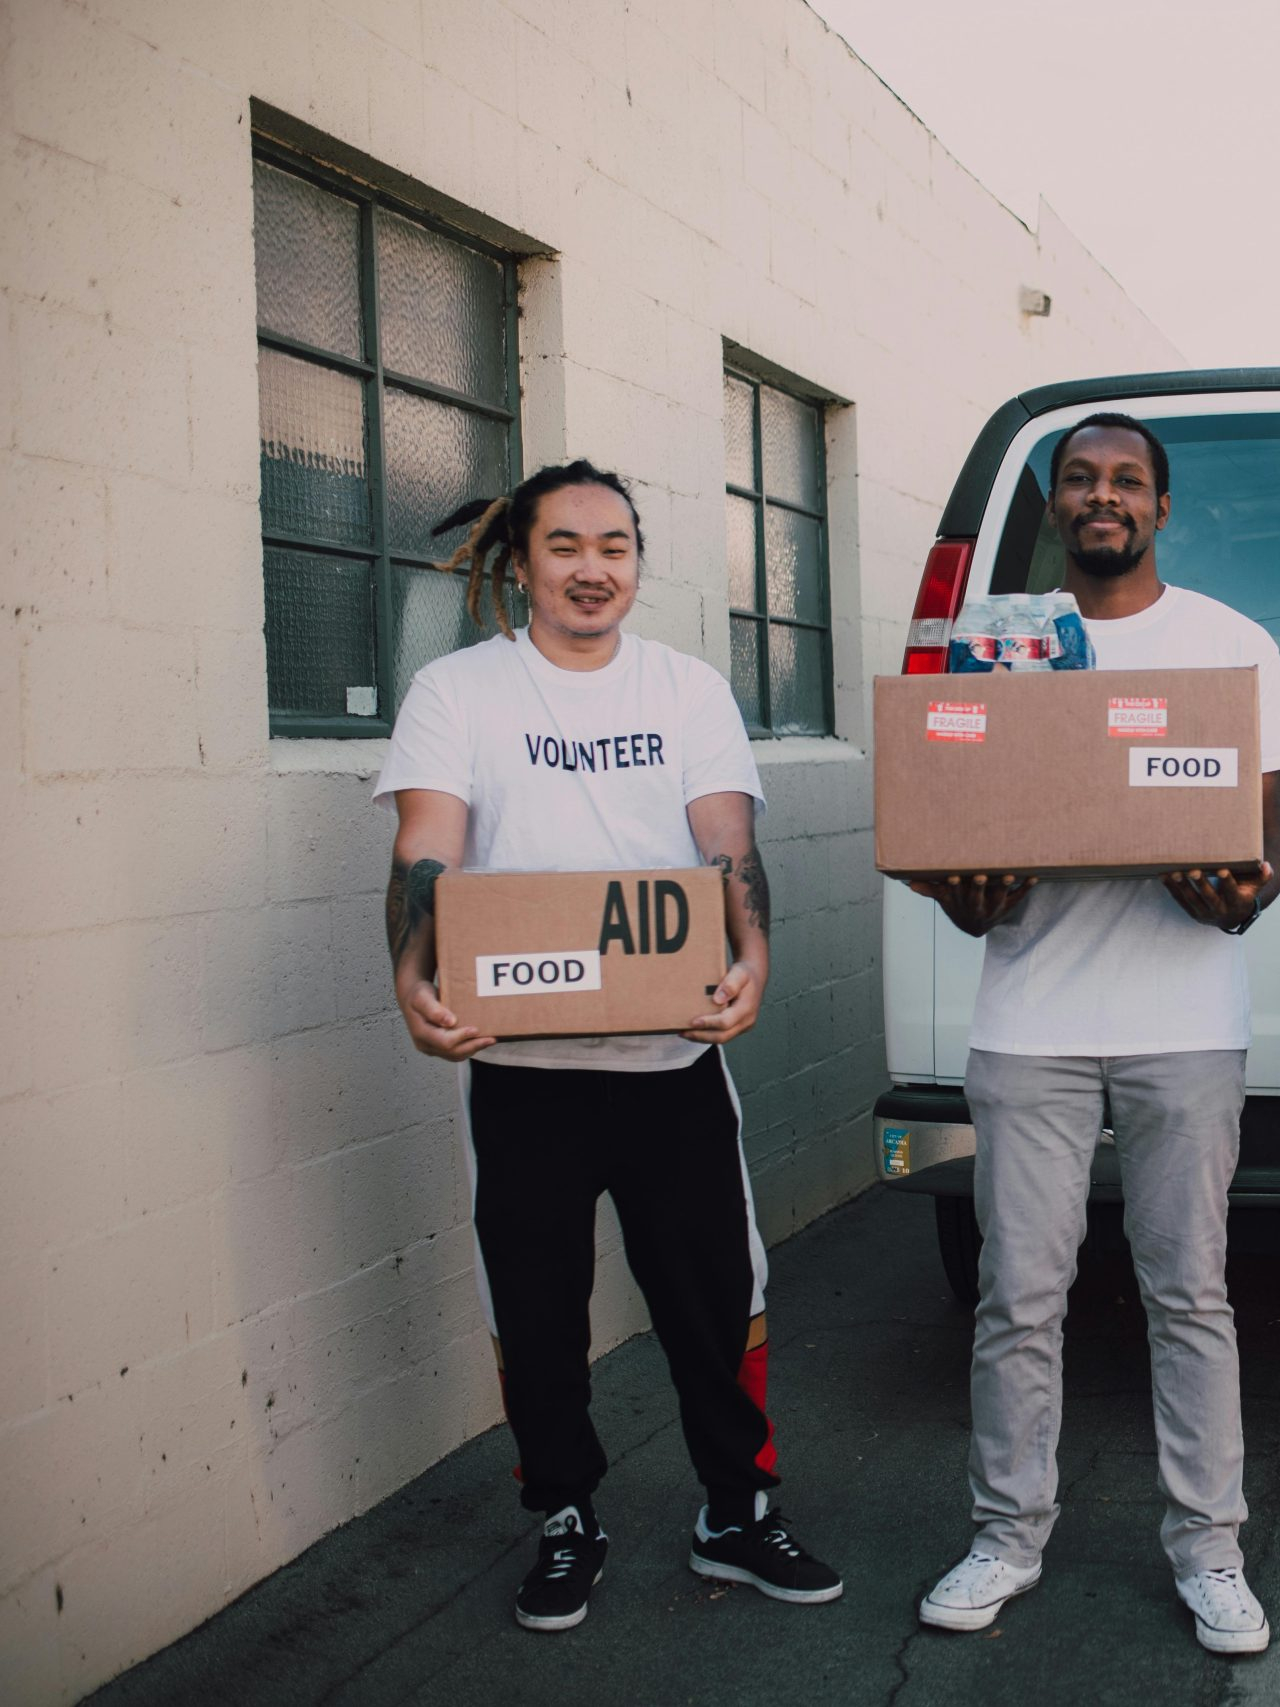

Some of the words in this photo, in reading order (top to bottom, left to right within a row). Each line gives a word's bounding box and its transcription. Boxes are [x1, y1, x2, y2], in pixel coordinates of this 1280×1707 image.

[932, 715, 982, 729] FRAGILE
[1113, 711, 1163, 725] FRAGILE
[525, 733, 665, 773] VOLUNTEER
[1147, 757, 1221, 778] FOOD
[599, 879, 690, 956] AID
[493, 959, 585, 987] FOOD
